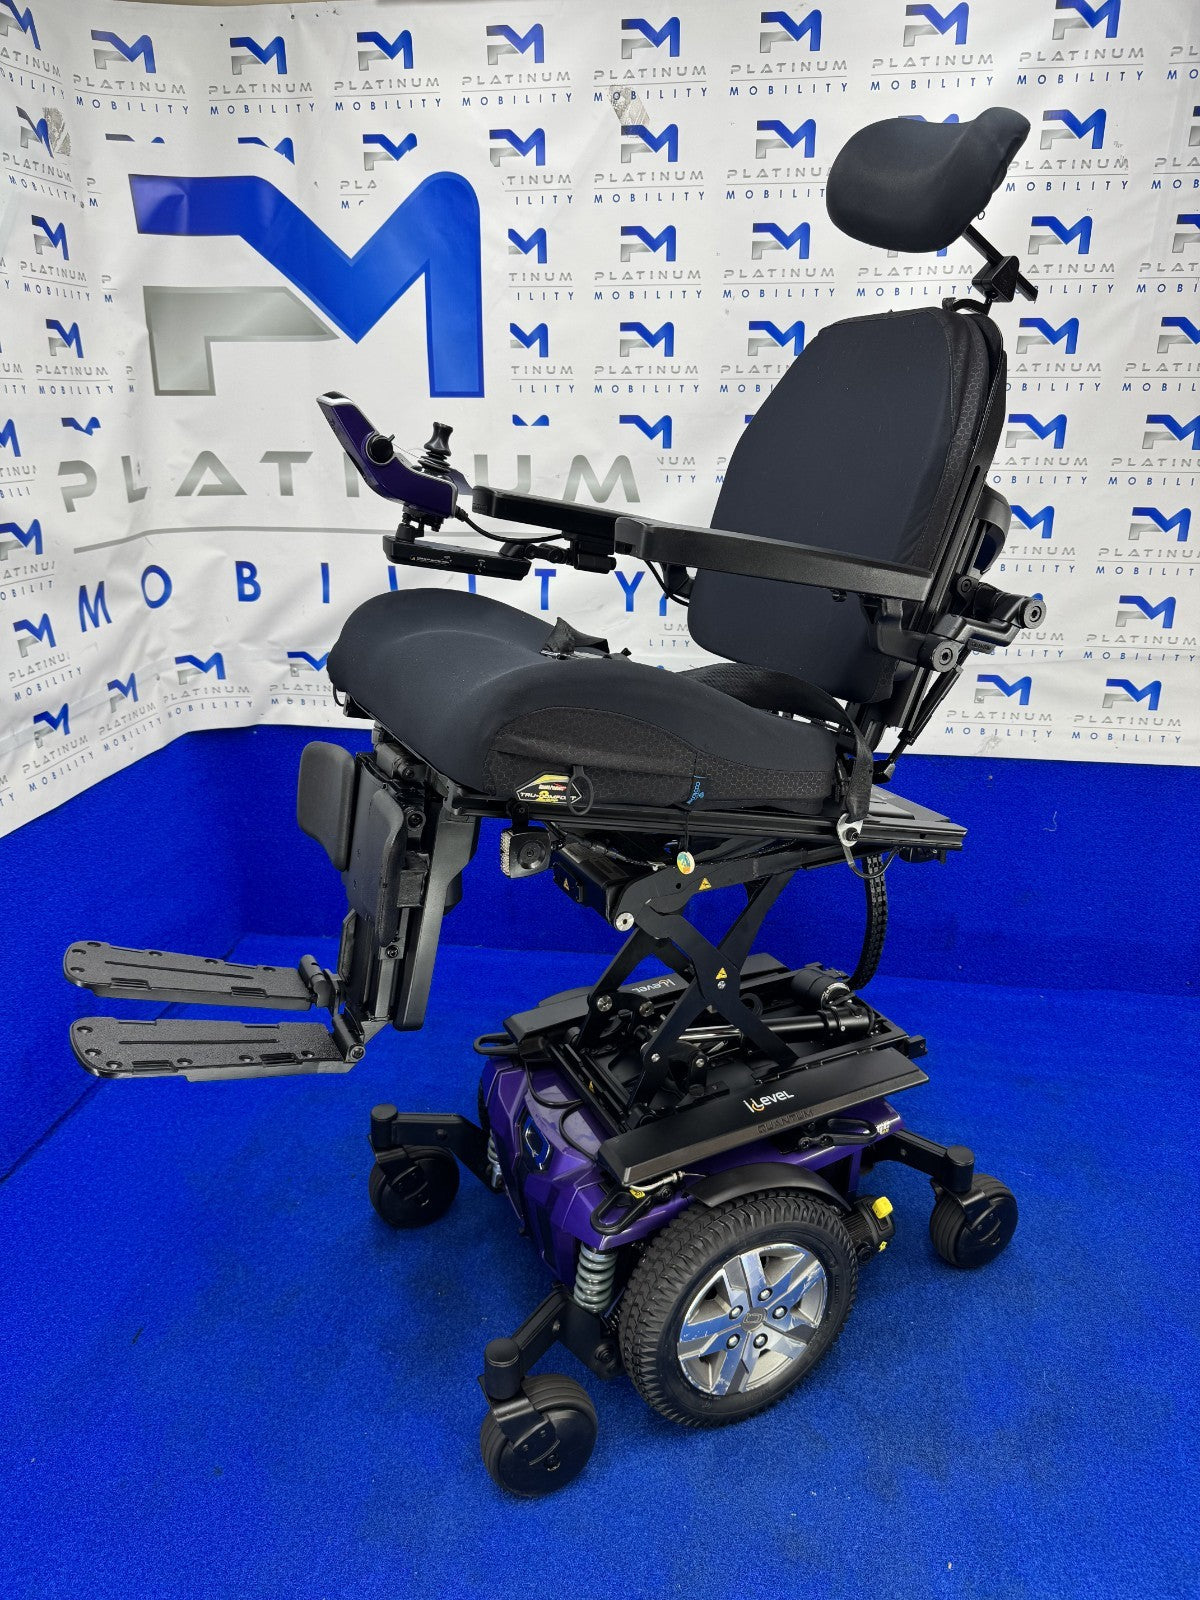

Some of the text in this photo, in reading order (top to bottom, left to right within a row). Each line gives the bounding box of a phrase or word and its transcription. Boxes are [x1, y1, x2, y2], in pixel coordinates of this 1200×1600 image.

[0, 47, 61, 78] ATINUM
[872, 54, 993, 69] PLATINUM
[1019, 48, 1144, 64] PLATINUM
[594, 66, 706, 80] PLATINUM
[731, 59, 847, 74] PLATINUM
[0, 66, 64, 99] OBILITY
[73, 74, 185, 95] PLATINUM
[334, 78, 439, 90] PLATINUM
[462, 71, 570, 85] PLATINUM
[870, 76, 993, 91] MOBILITY
[1017, 71, 1144, 86] MOBILITY
[209, 82, 312, 94] PLATINUM
[594, 87, 707, 102] MOBILITY
[730, 80, 847, 96] MOBILITY
[75, 96, 188, 114] MOBILITY
[335, 97, 441, 112] MOBILITY
[462, 92, 572, 106] MOBILITY
[210, 102, 314, 115] MOBILITY
[2, 152, 72, 182] PLATINUM
[727, 167, 830, 179] PLATINU
[502, 174, 571, 185] TINUM
[594, 171, 703, 183] PLATINUM
[8, 174, 77, 203] MOBILITY
[1005, 180, 1128, 192] MOBILITY
[594, 191, 704, 203] MOBILITY
[20, 261, 86, 282] PLATINUM
[724, 268, 834, 278] PLATINUM
[858, 265, 973, 277] PLATINUM
[1018, 263, 1115, 273] ATINUM
[595, 270, 701, 280] PLATINUM
[24, 283, 90, 301] MOBILITY
[594, 290, 702, 301] MOBILITY
[722, 288, 835, 301] MOBILITY
[856, 284, 973, 297] MOBILITY
[36, 365, 108, 376] PLATINUM
[595, 365, 698, 374] PLATINUM
[1007, 362, 1101, 372] ATINUM
[39, 384, 113, 394] MOBILITY
[593, 384, 699, 396] MOBILITY
[993, 456, 1088, 466] ATINUM
[1086, 634, 1197, 645] PLATINUM
[1084, 652, 1196, 662] MOBILITY
[9, 653, 70, 682] PLATINU
[14, 667, 81, 701] MOBILITY
[163, 686, 250, 703] PLATINUM
[99, 703, 158, 735] PLATINUM
[947, 710, 1052, 721] PLATINUM
[1074, 715, 1181, 726] PLATINUM
[103, 717, 161, 751] MOBILITY
[944, 727, 1052, 739] MOBILITY
[1072, 732, 1181, 743] MOBILITY
[22, 735, 89, 773] PLATINUM
[28, 751, 93, 792] MOBILITY
